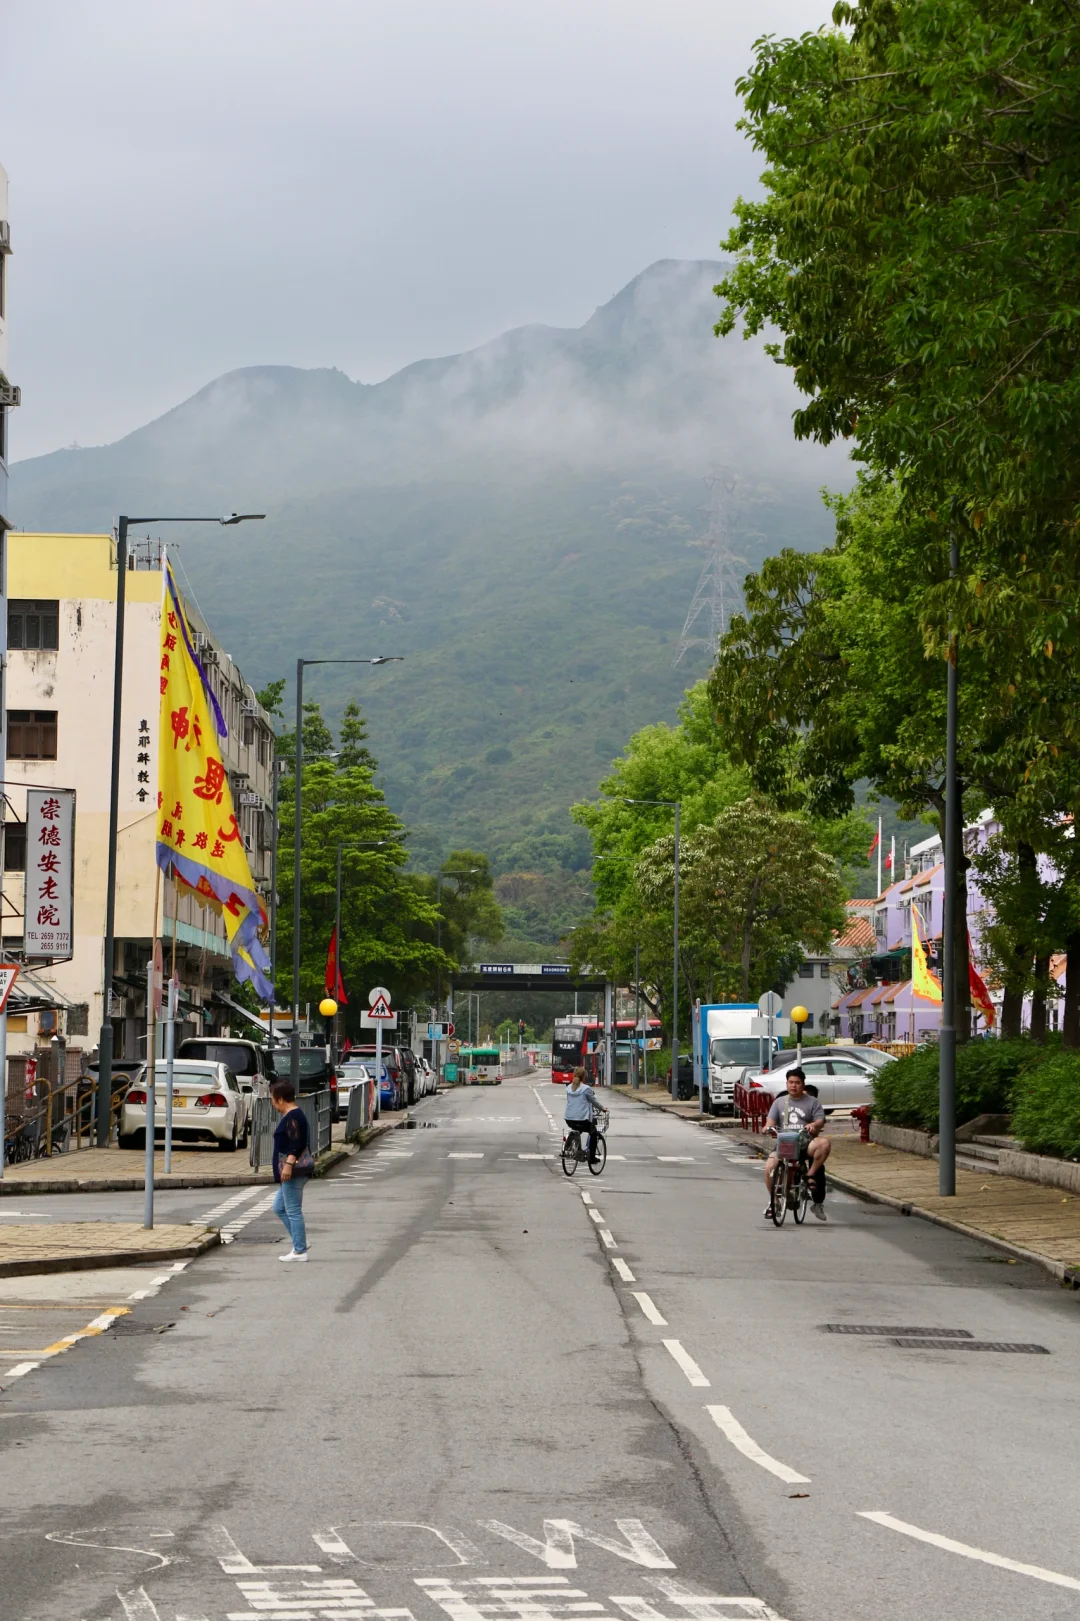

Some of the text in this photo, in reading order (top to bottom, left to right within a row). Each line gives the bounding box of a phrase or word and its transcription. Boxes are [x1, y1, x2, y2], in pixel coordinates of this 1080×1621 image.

[136, 718, 151, 802] 真耶穌教會
[37, 797, 61, 926] 崇德安老院
[40, 942, 68, 950] 2655 9111
[56, 932, 70, 941] 7372
[45, 1518, 677, 1575] SLOW
